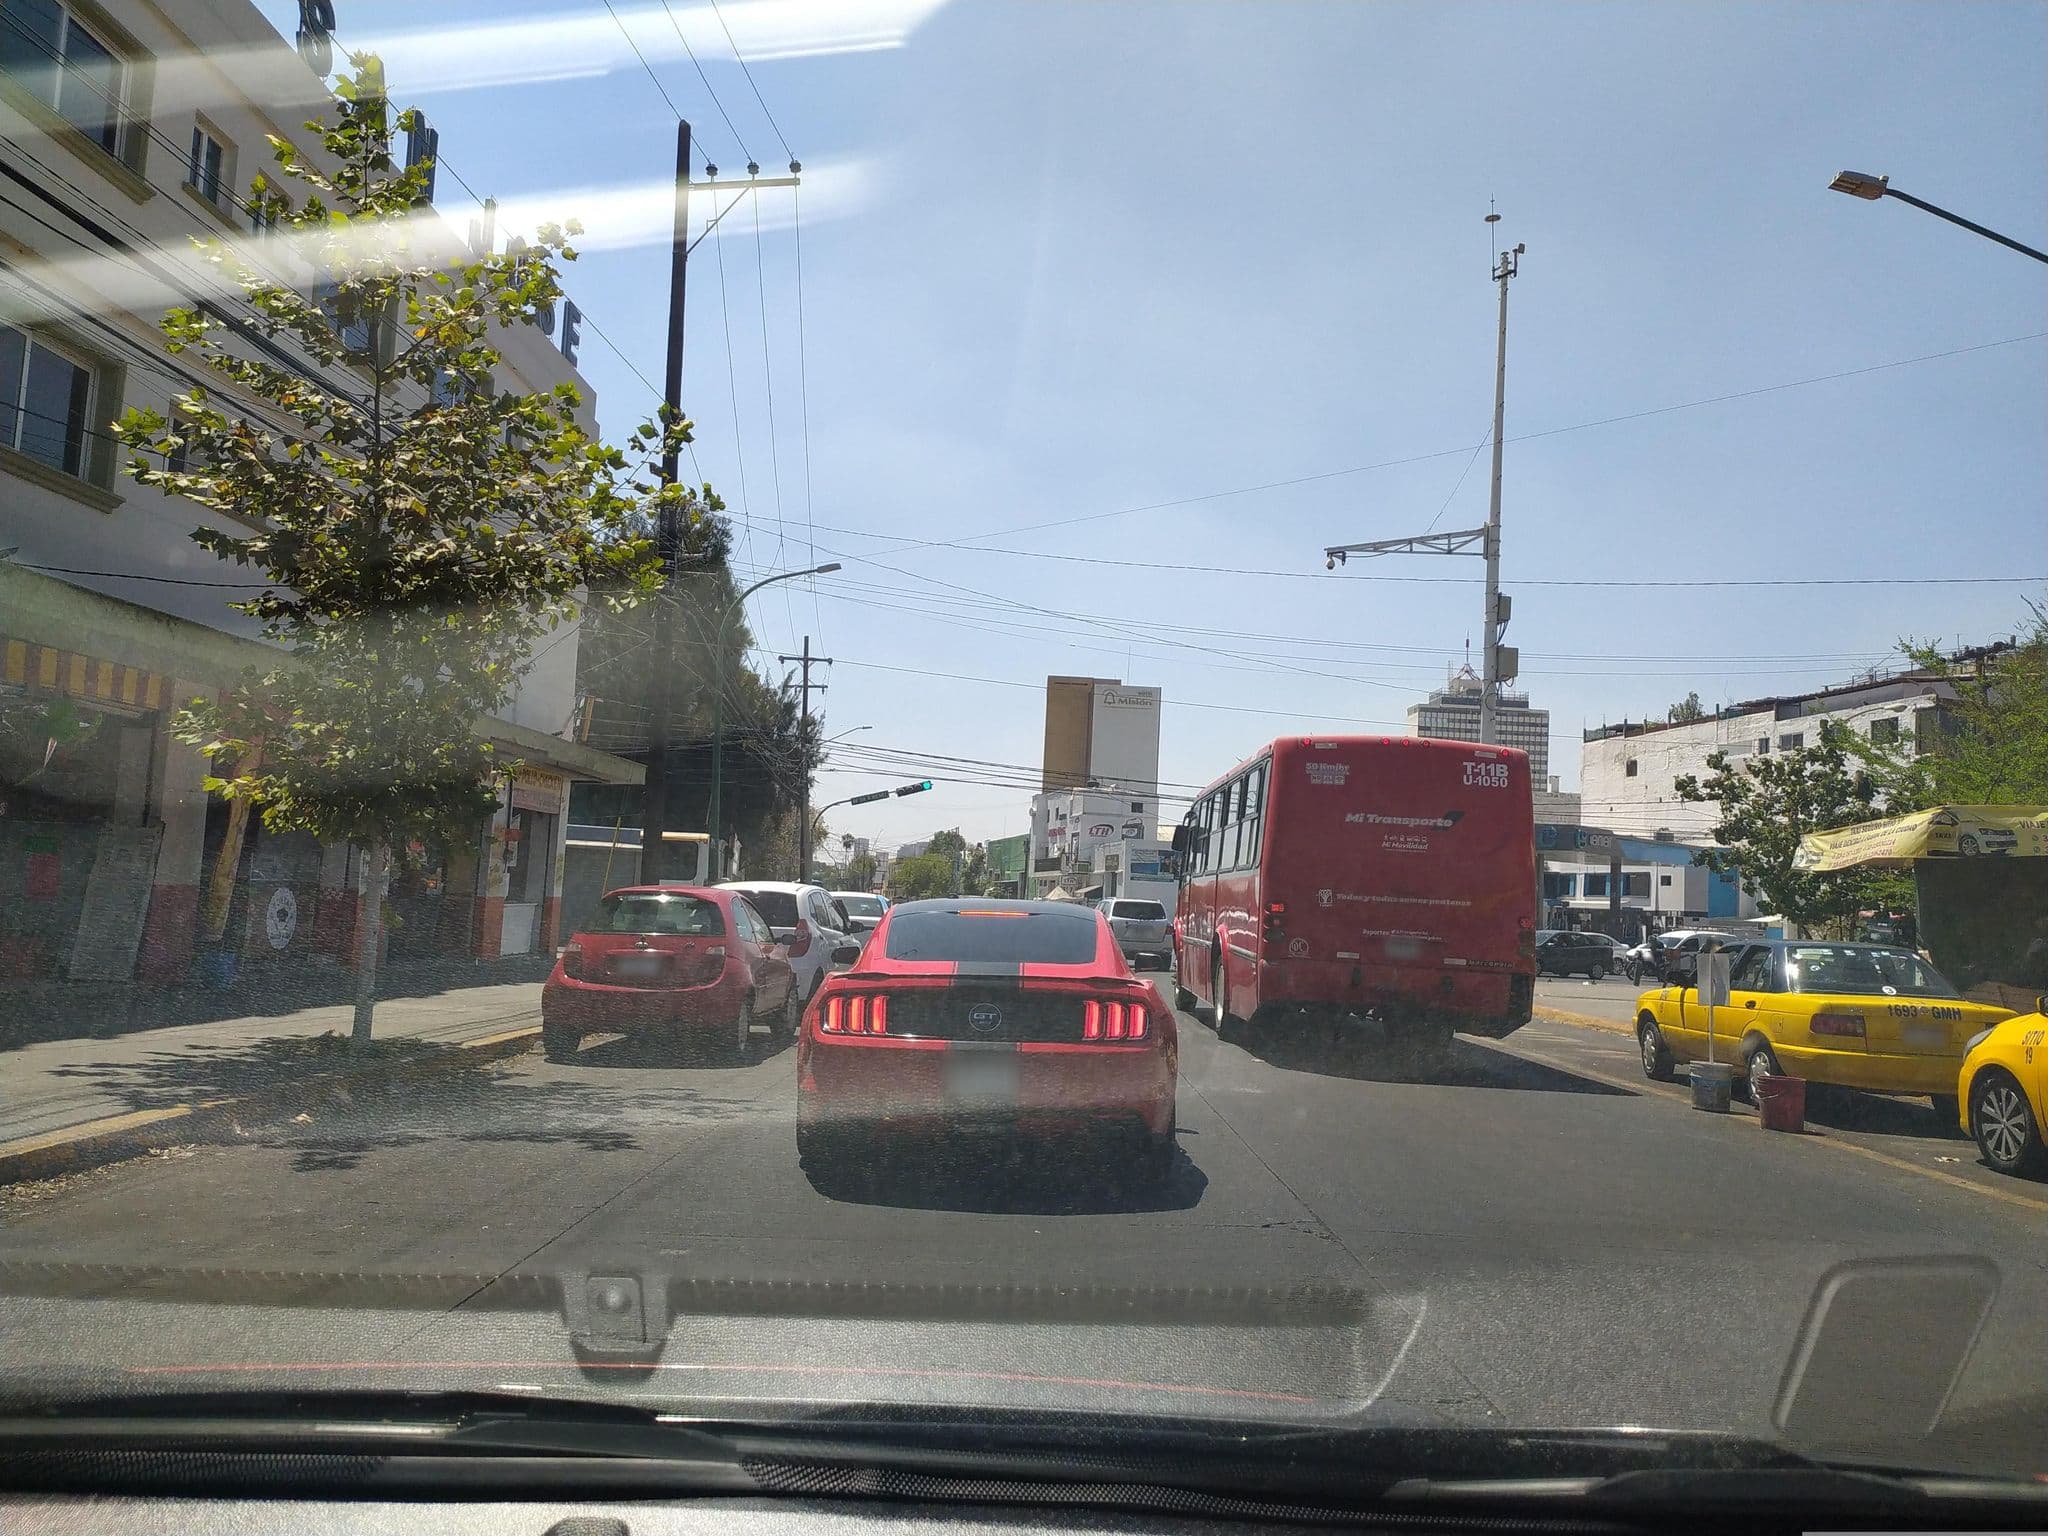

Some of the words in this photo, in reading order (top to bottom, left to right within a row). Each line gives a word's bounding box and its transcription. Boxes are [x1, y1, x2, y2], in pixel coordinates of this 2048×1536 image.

[1463, 761, 1509, 777] T-11B
[1463, 775, 1508, 788] U-1050
[1345, 813, 1365, 823] Mi
[1366, 814, 1454, 828] Transporte
[1392, 842, 1428, 850] Movilidad
[973, 1012, 997, 1020] GT
[1888, 1004, 1918, 1018] 1693
[1932, 1007, 1962, 1021] GMH
[2021, 1030, 2045, 1045] SITIO
[2025, 1046, 2033, 1064] 19
